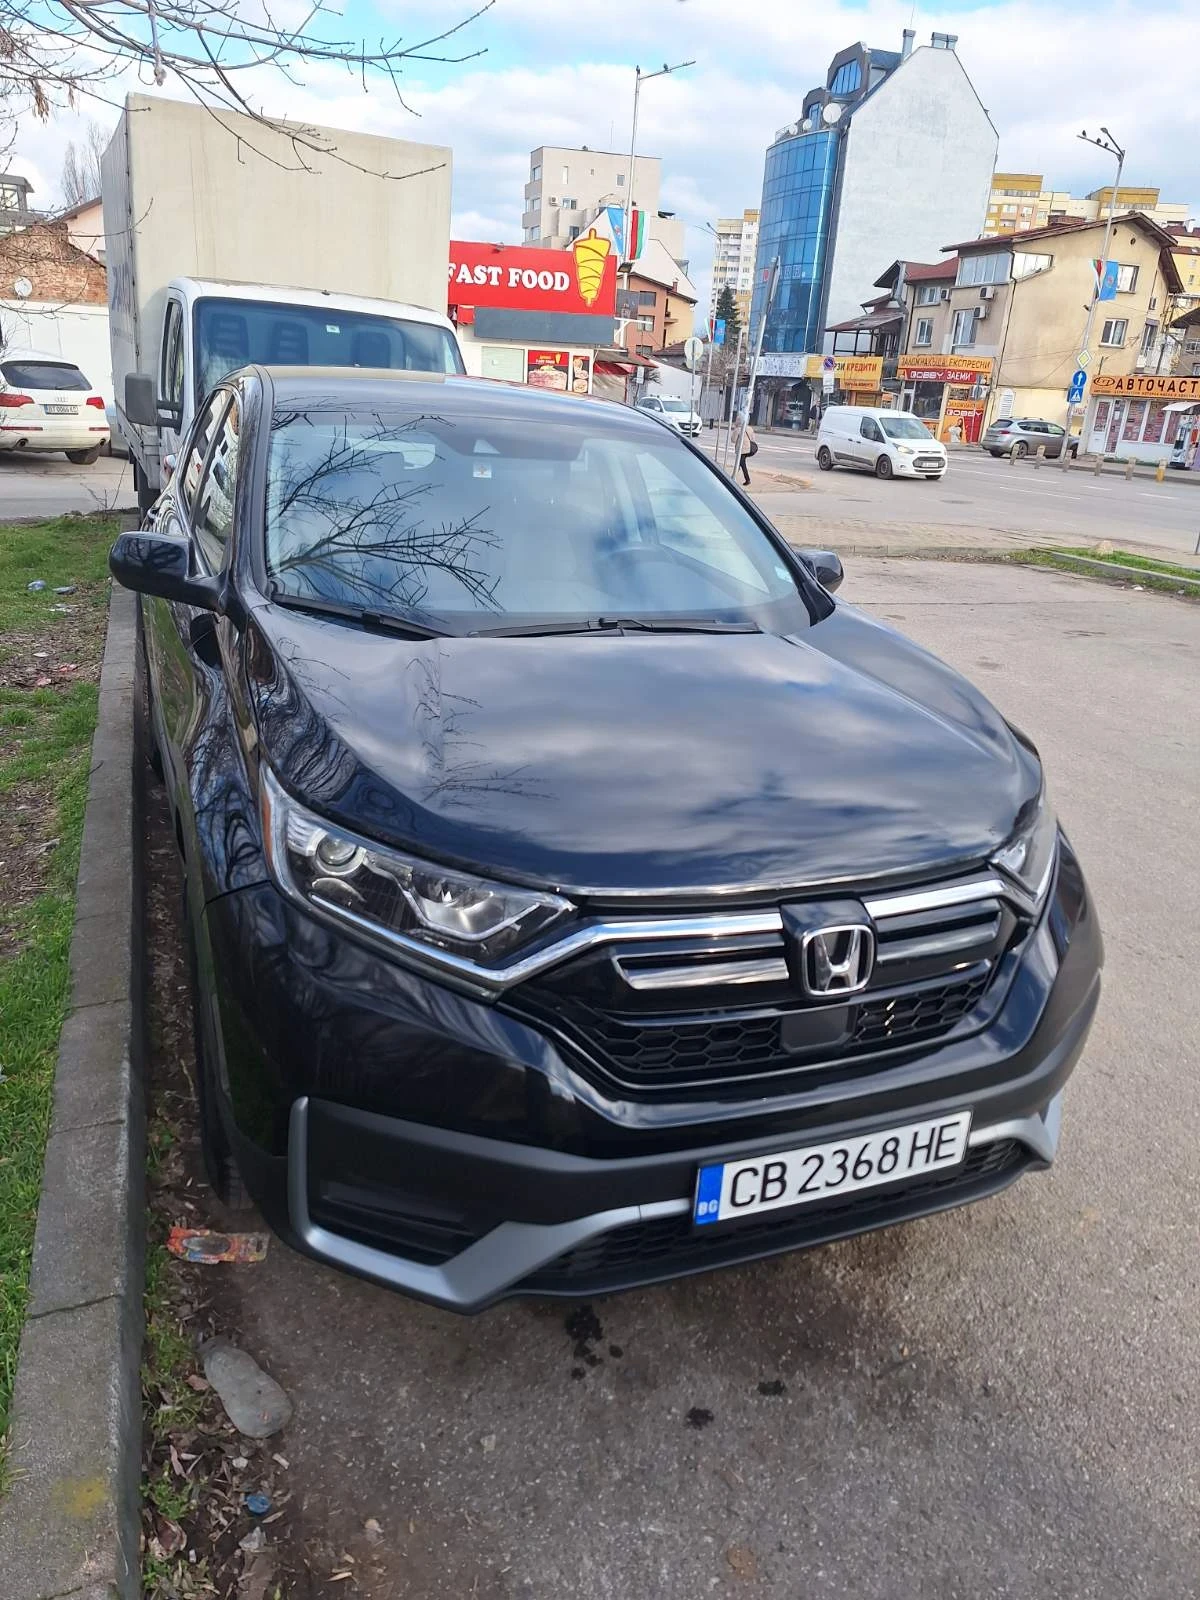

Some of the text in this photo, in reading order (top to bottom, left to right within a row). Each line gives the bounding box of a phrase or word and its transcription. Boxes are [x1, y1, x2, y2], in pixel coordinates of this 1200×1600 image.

[508, 267, 570, 291] FOOD
[846, 362, 877, 372] КРЕДИТИ
[948, 358, 990, 369] ЕКСПРЕСНИ
[946, 372, 971, 381] ЗАЕМИ
[1115, 378, 1199, 394] АВТОЧАСТ
[730, 1122, 960, 1207] CB 2368 HE
[698, 1202, 718, 1216] BG
